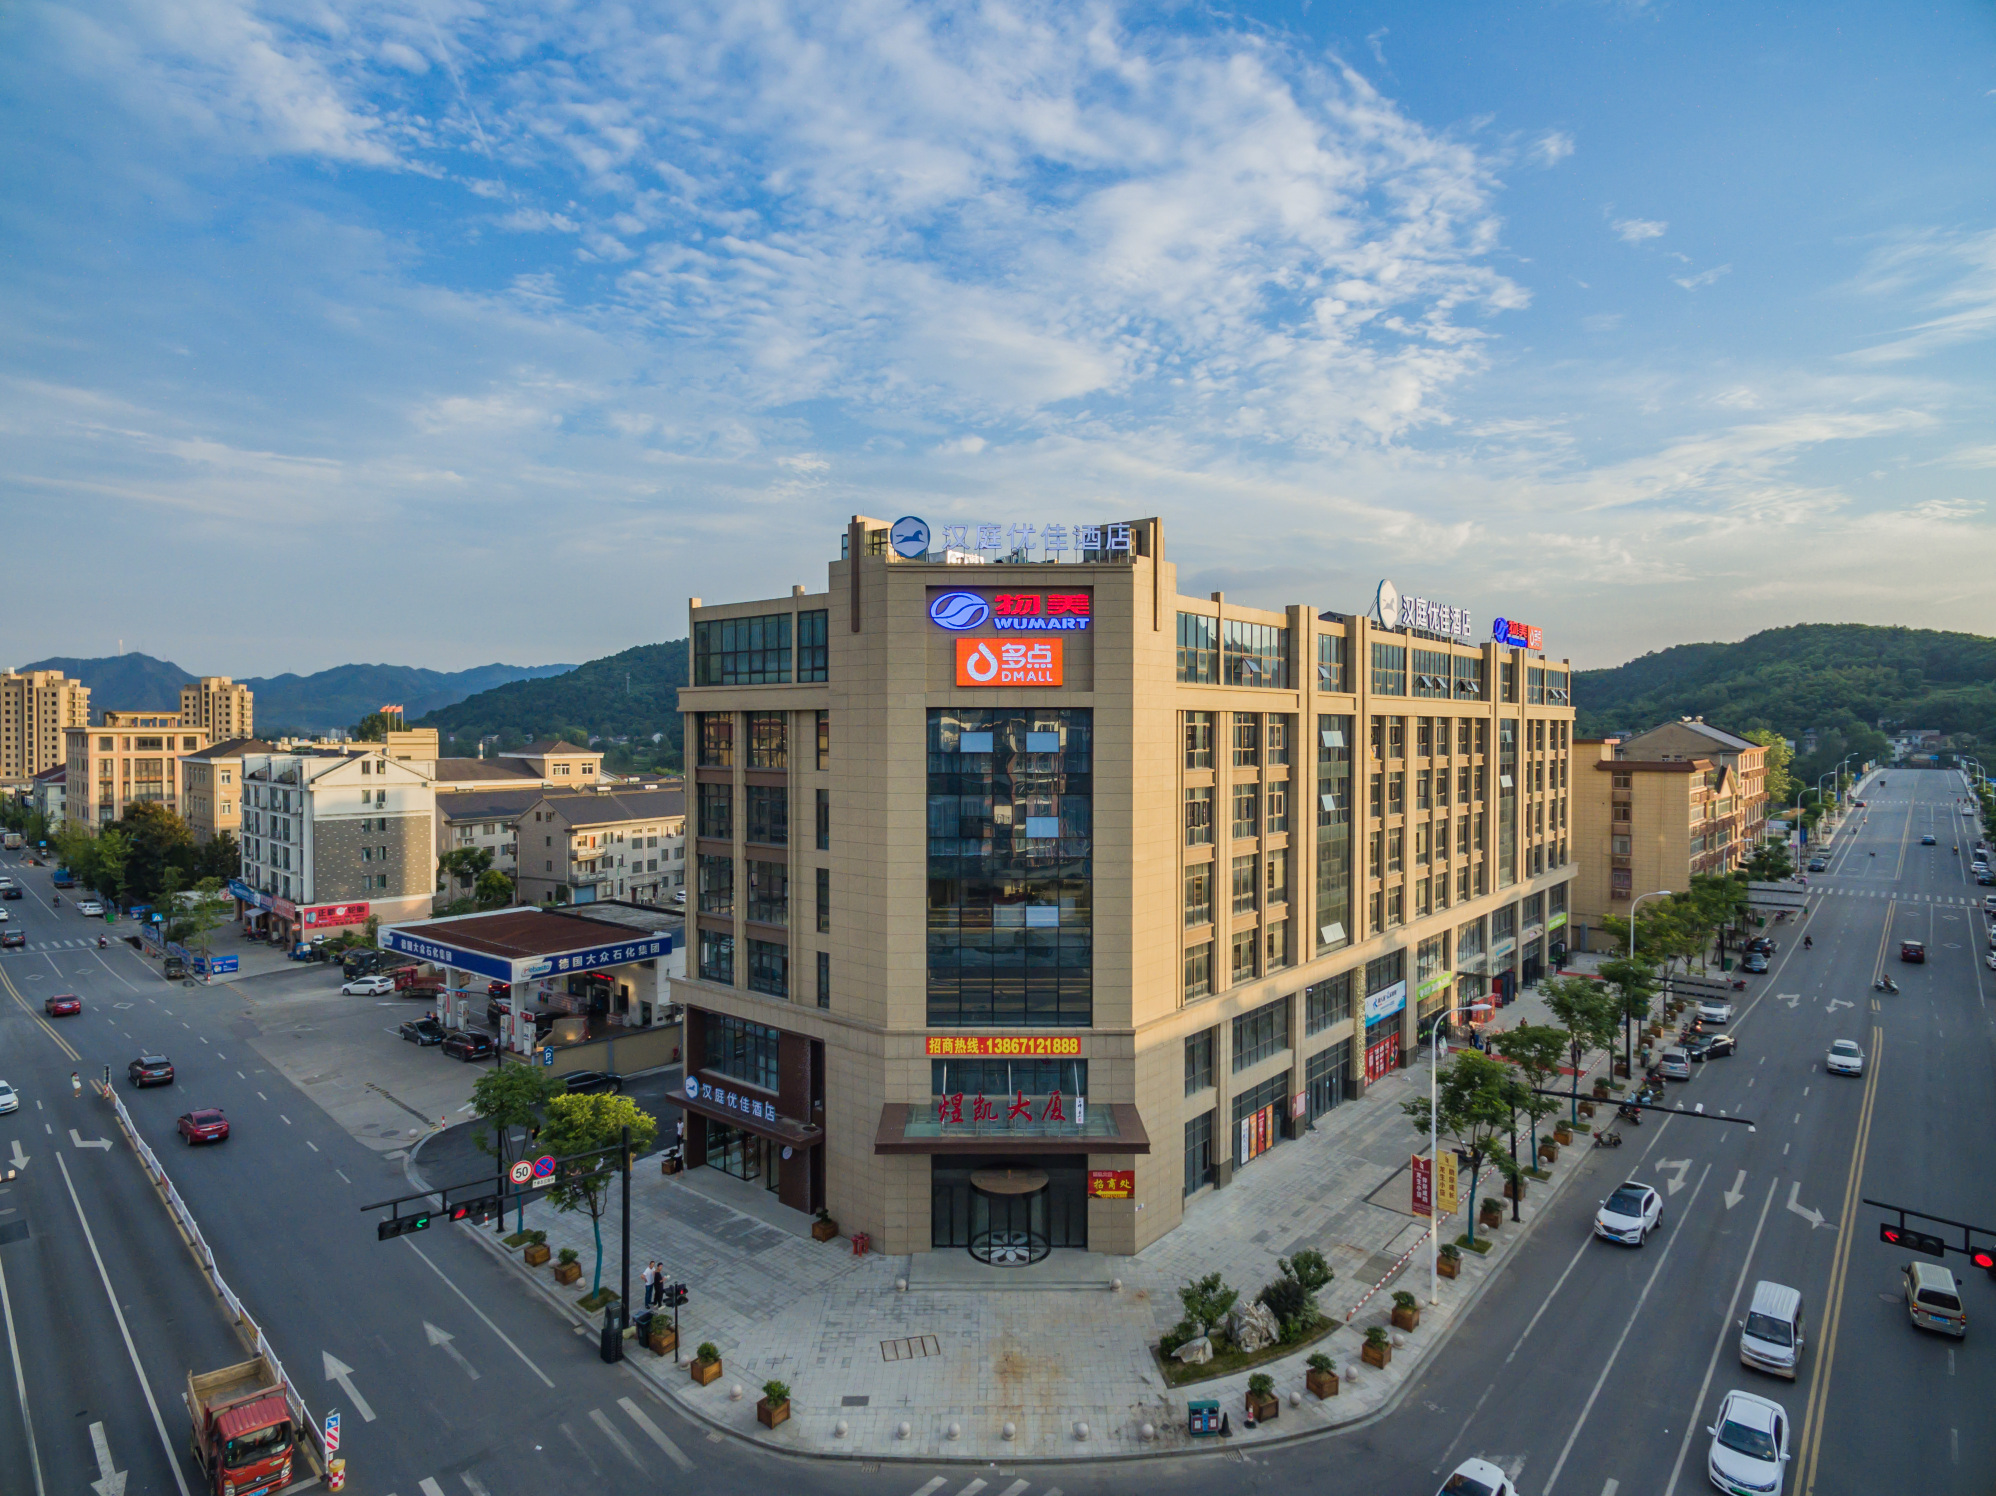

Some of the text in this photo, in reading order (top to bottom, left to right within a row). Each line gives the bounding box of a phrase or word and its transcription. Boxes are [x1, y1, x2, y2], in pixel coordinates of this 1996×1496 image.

[942, 522, 1131, 551] 汉庭优佳酒店
[994, 593, 1090, 615] 物美
[1401, 594, 1471, 637] 汉庭优佳酒店
[993, 617, 1090, 630] WUMART
[1001, 643, 1053, 669] 多点
[1001, 671, 1053, 682] DMALL
[558, 942, 660, 970] 德国大众石化集团
[545, 1052, 552, 1061] P
[702, 1083, 776, 1123] 汉庭优佳酒店
[938, 1089, 1067, 1123] 煜凯大厦
[515, 1166, 529, 1179] 50
